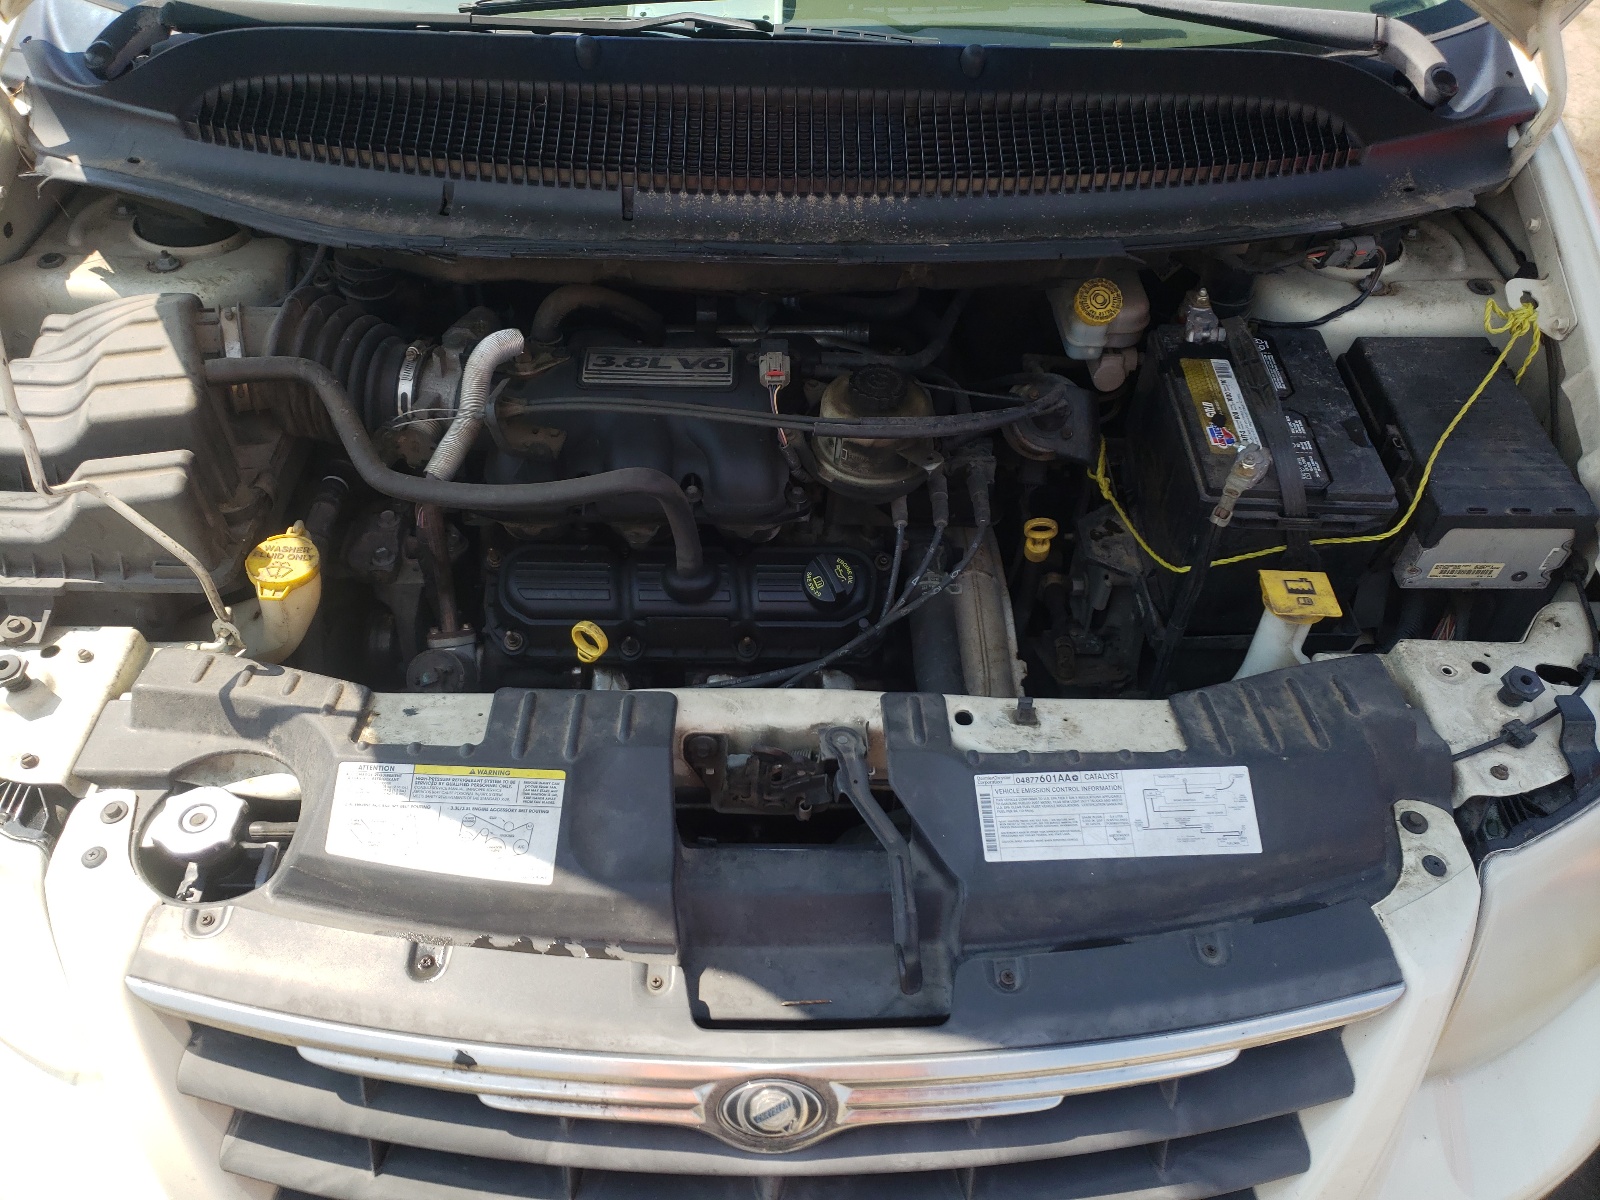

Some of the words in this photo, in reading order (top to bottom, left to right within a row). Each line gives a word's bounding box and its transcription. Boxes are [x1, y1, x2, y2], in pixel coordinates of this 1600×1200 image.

[592, 355, 672, 370] 3.8L
[676, 357, 726, 370] V6
[264, 544, 314, 554] WASHER
[252, 550, 284, 560] FLUID
[287, 553, 316, 562] ONLY
[836, 558, 852, 575] ENGINE
[1016, 774, 1071, 784] 04877601AA
